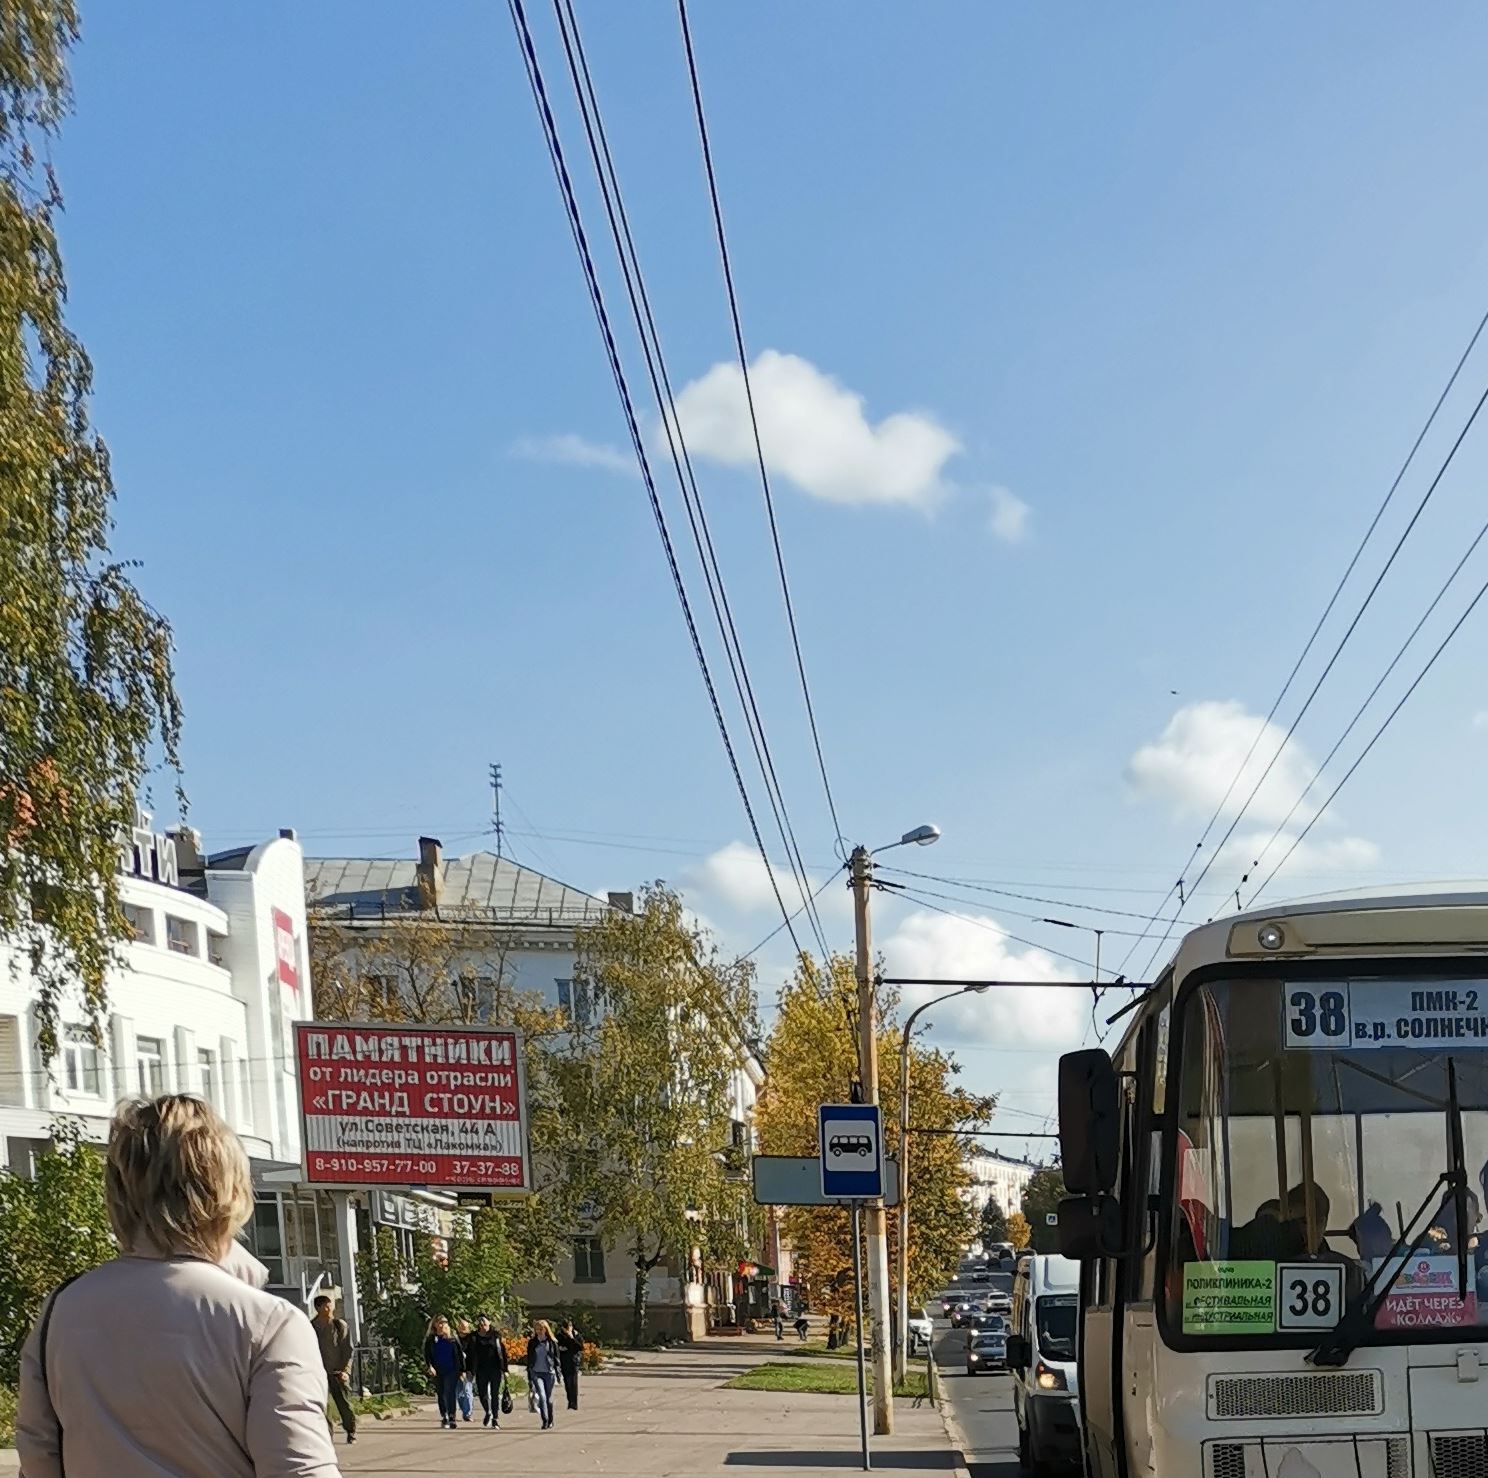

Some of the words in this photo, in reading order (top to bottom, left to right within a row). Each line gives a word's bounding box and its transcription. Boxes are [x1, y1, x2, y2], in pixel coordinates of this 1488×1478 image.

[1411, 990, 1478, 1012] ПМК-2
[1291, 991, 1346, 1037] 38
[1354, 1021, 1392, 1041] в.р.
[307, 1033, 512, 1065] ПАМЯТНИКИ
[309, 1067, 333, 1082] от
[338, 1068, 419, 1089] лидера
[426, 1071, 513, 1090] отрасли
[312, 1090, 409, 1115] «ГРАНД
[424, 1093, 516, 1116] СТОУН»
[460, 1121, 480, 1135] 44
[484, 1121, 496, 1136] А
[336, 1137, 401, 1151] (напротив
[406, 1138, 421, 1152] ТЦ
[426, 1138, 503, 1153] «Лакомка»)
[315, 1158, 437, 1174] 8-910-957-77-00
[452, 1161, 519, 1175] 37-37-88
[1186, 1278, 1273, 1290] ПОЛИКЛИНИКА-2
[1289, 1279, 1332, 1317] 38
[1386, 1296, 1421, 1312] ИДЁТ
[1424, 1297, 1465, 1311] ЧЕРЕЗ
[1391, 1311, 1462, 1327] «КОЛЛАЖ»
